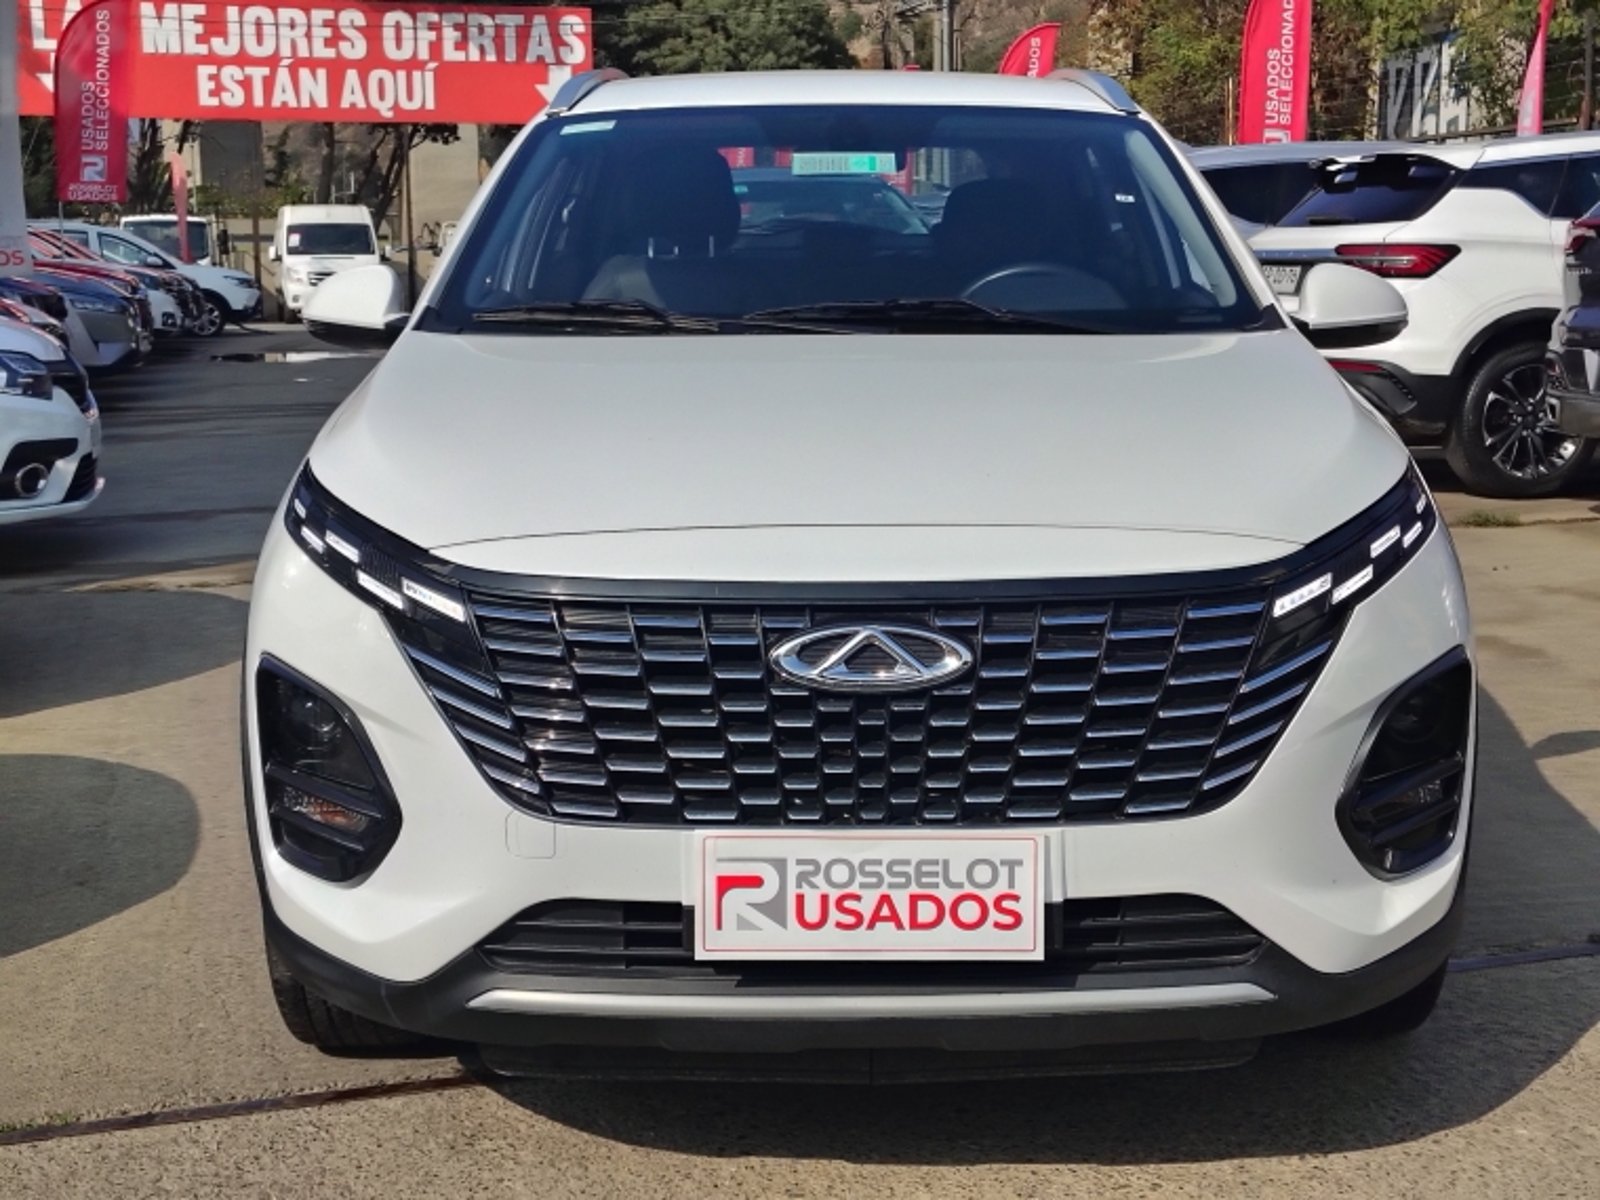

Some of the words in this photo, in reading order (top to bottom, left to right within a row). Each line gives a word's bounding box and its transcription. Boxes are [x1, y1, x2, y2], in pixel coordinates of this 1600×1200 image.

[139, 2, 367, 60] MEJORES
[382, 11, 586, 64] OFERTAS
[96, 10, 110, 150] SELECCIONADOS
[197, 58, 328, 108] ESTÁN
[340, 62, 439, 118] AQUÍ
[1265, 48, 1280, 124] USADOS
[82, 81, 95, 150] USADOS
[67, 190, 118, 201] USADOS
[795, 858, 1024, 889] ROSSELOT
[795, 893, 1024, 931] USADOS
